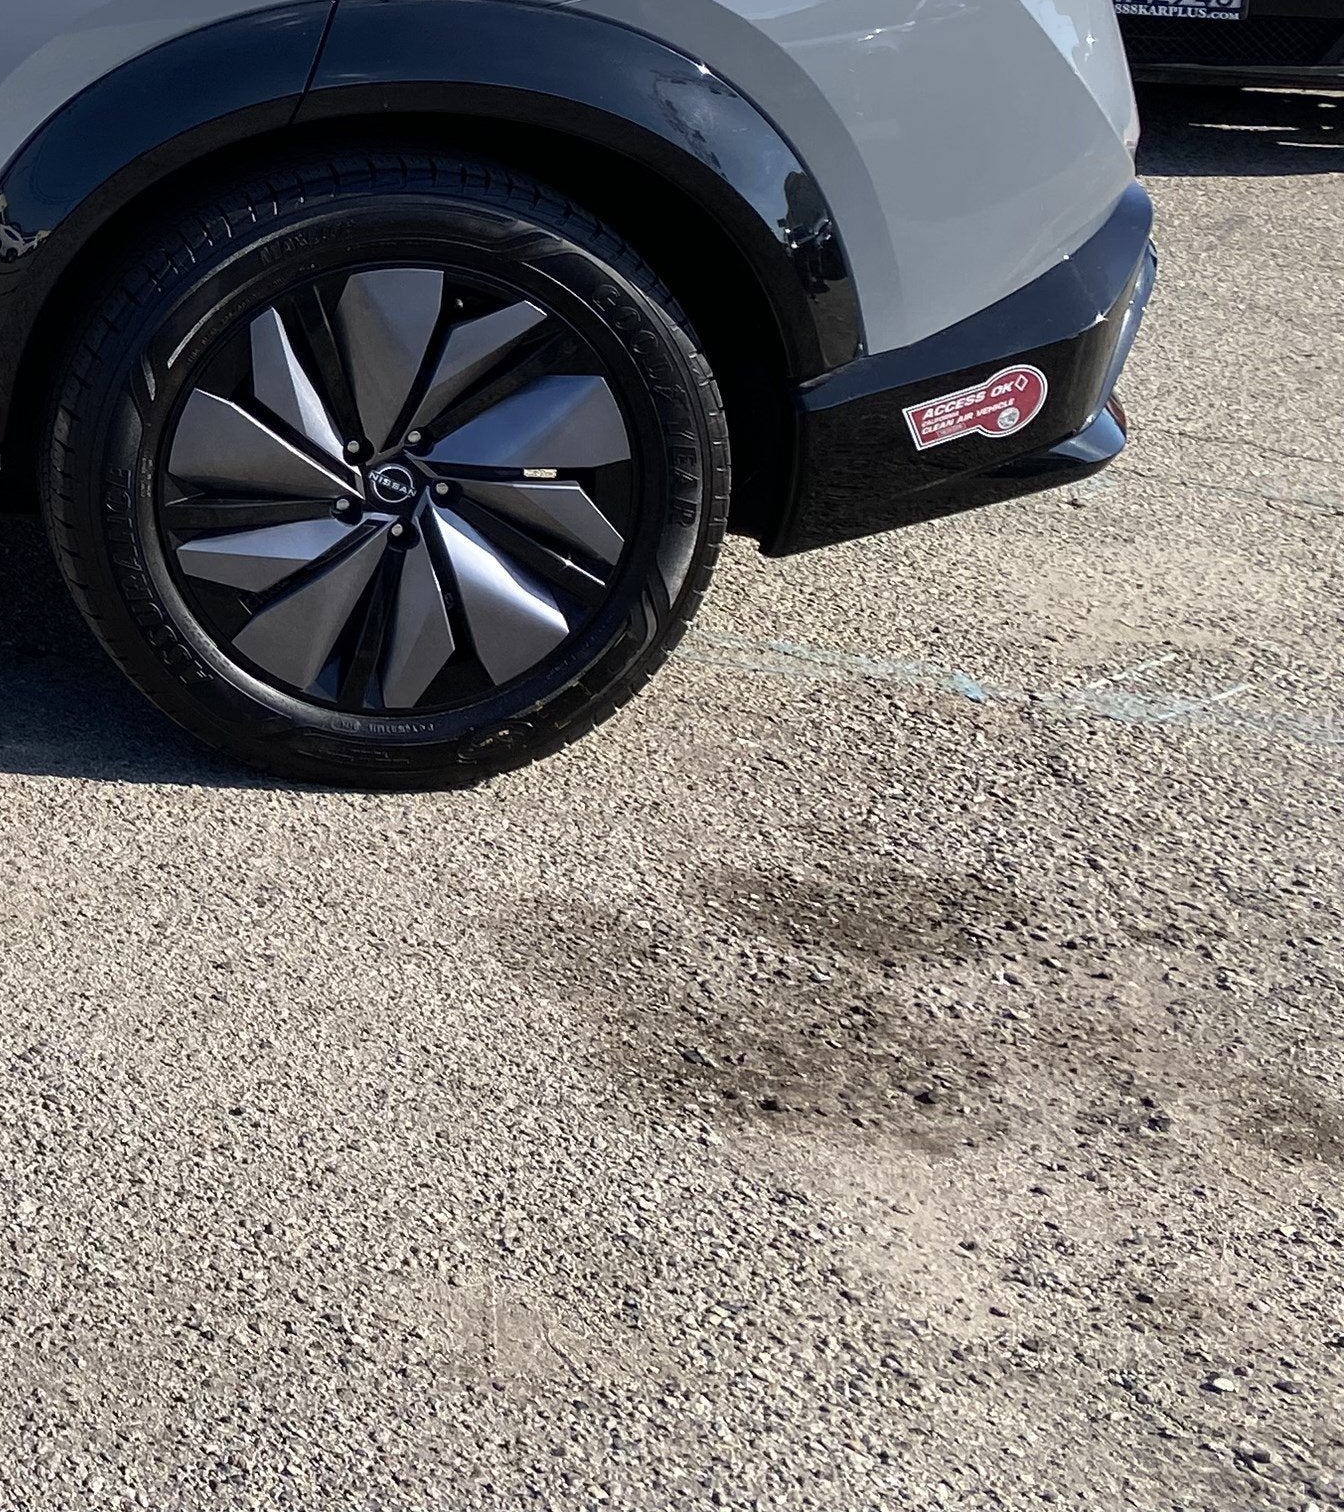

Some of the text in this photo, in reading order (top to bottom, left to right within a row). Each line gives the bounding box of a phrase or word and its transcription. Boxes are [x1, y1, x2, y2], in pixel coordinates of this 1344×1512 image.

[922, 380, 1015, 420] ACCESS OK
[922, 419, 955, 435] CLEAN
[957, 412, 974, 424] AIR
[976, 398, 1015, 417] VEHICLE
[369, 471, 417, 497] NISSAN
